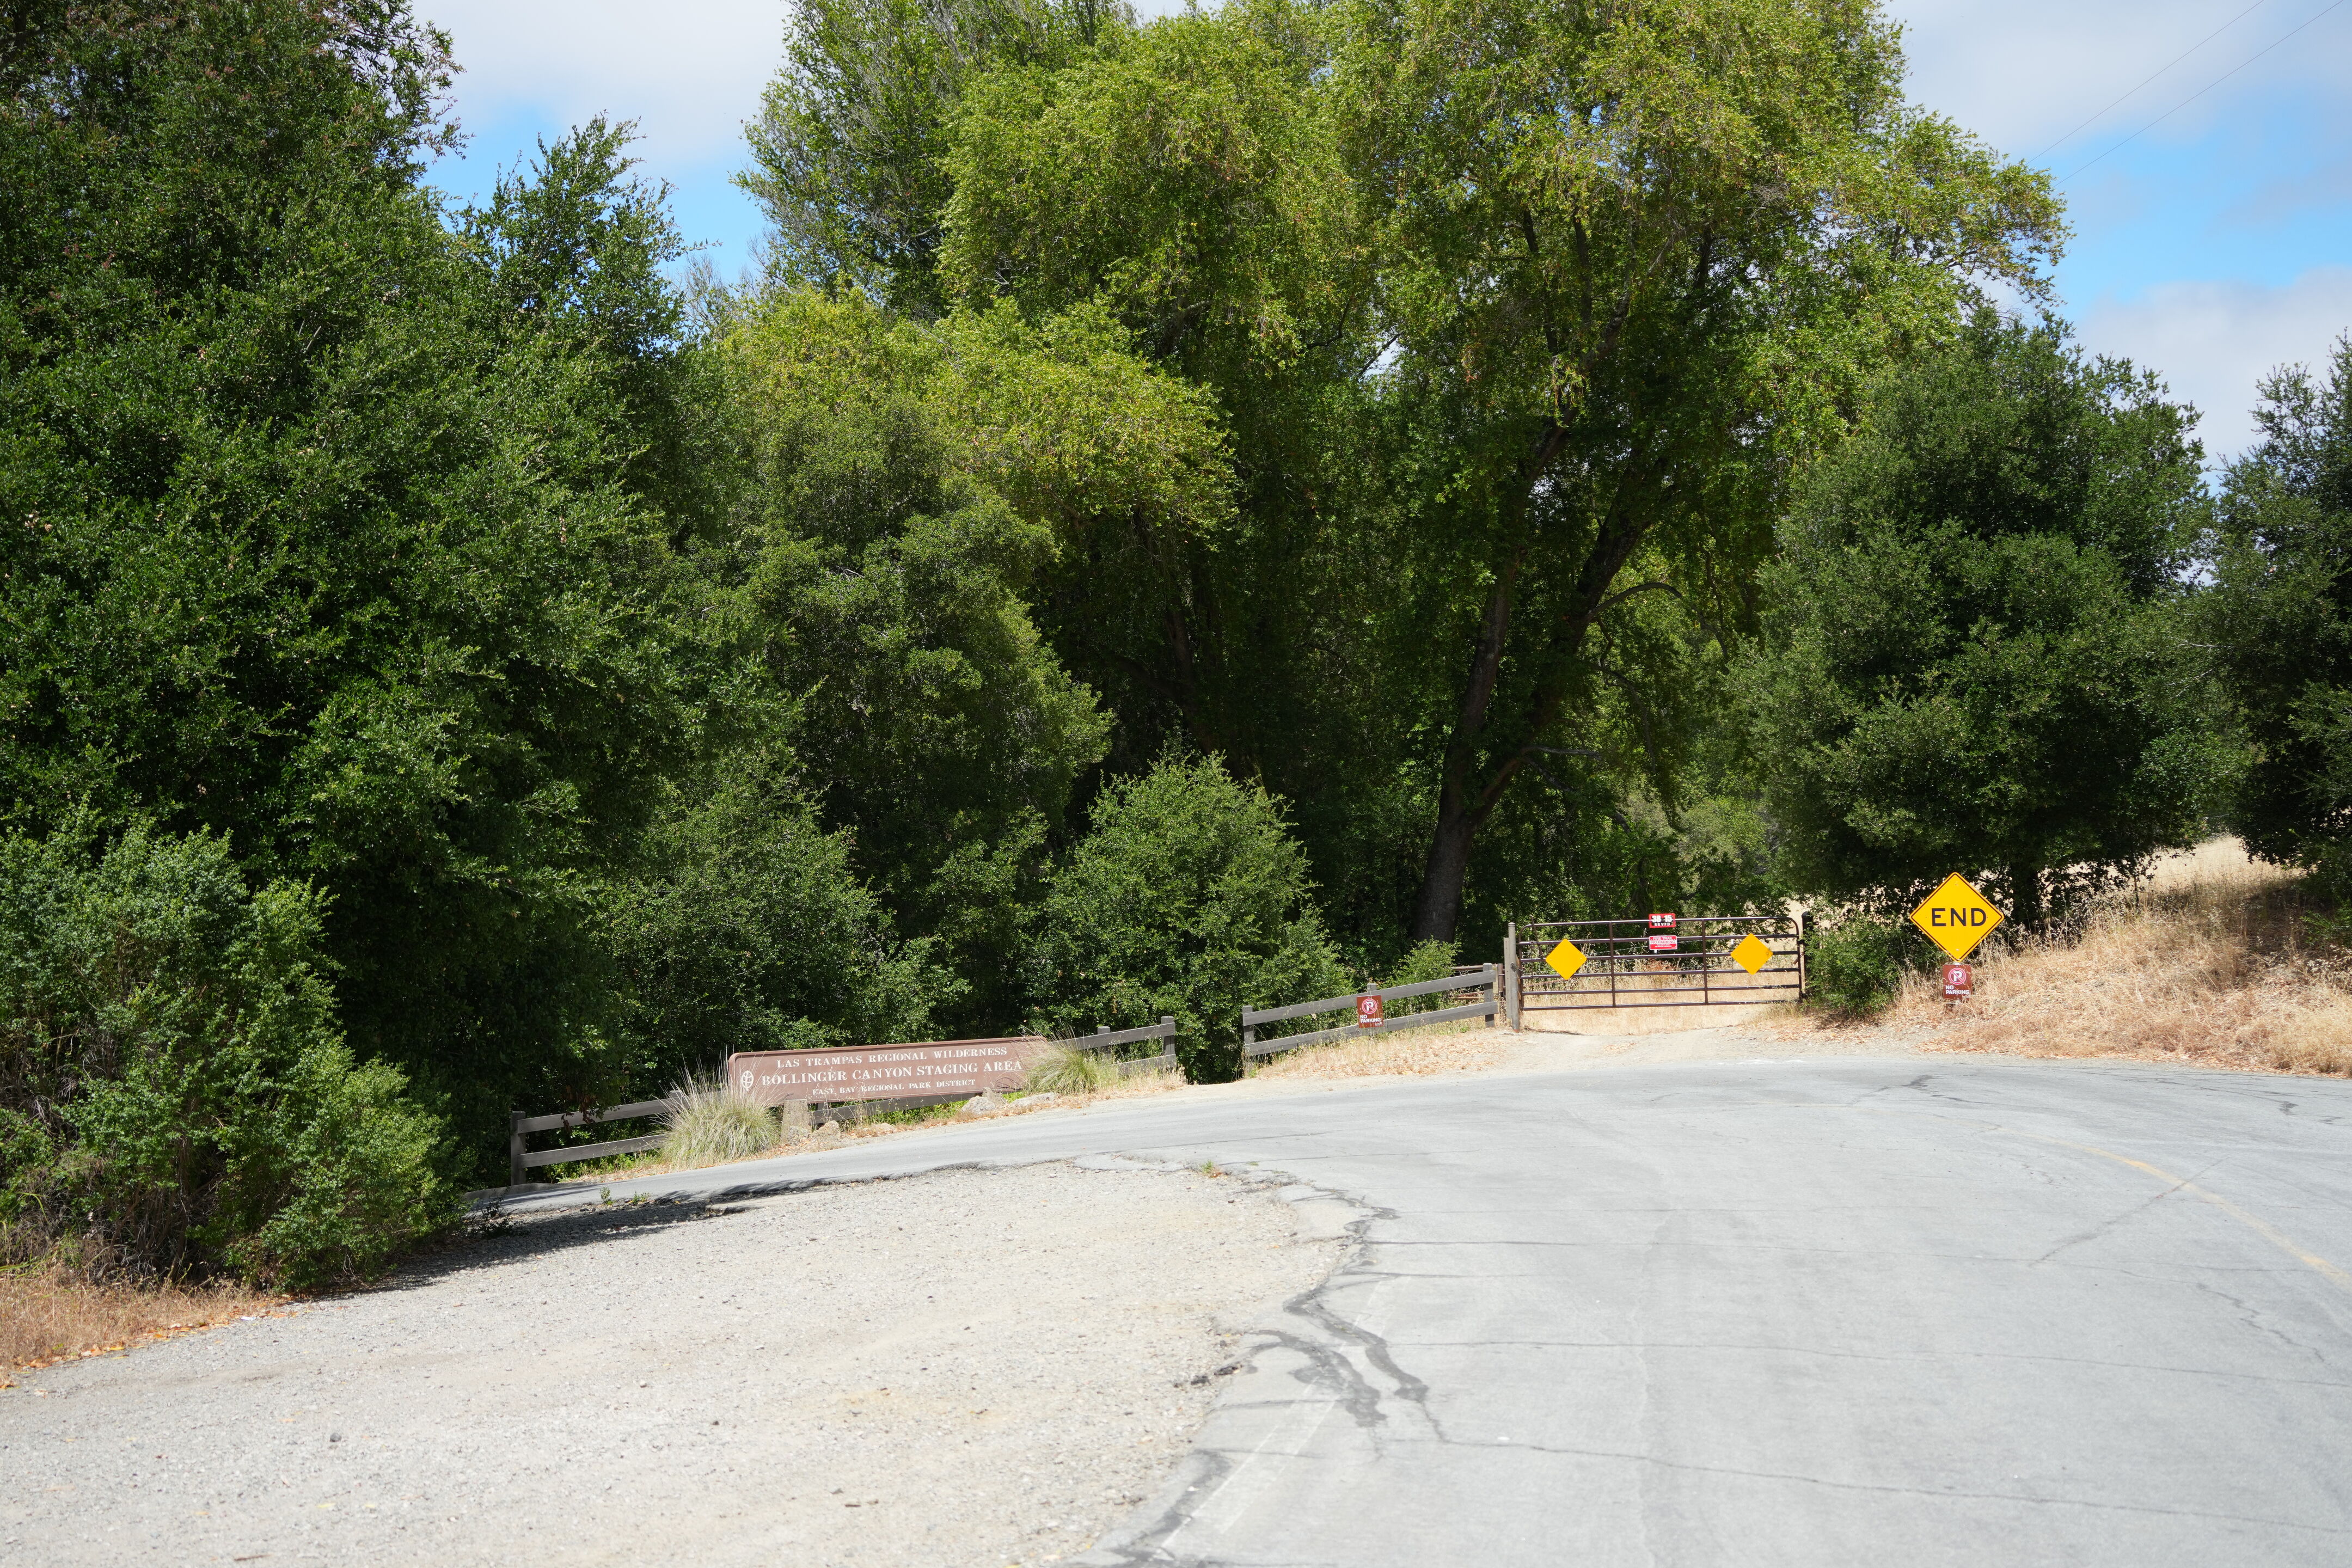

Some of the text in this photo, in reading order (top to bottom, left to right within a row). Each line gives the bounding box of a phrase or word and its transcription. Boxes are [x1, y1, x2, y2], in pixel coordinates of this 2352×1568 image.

[1931, 908, 1987, 927] END
[776, 1046, 1007, 1068] LAS TRAMPAS REGIONAL WILDERNESS
[762, 1061, 1022, 1086] BOLLINGER CANYON STAGING AREA
[861, 1083, 904, 1092] REGIONAL
[936, 1079, 976, 1088] DISTRICT
